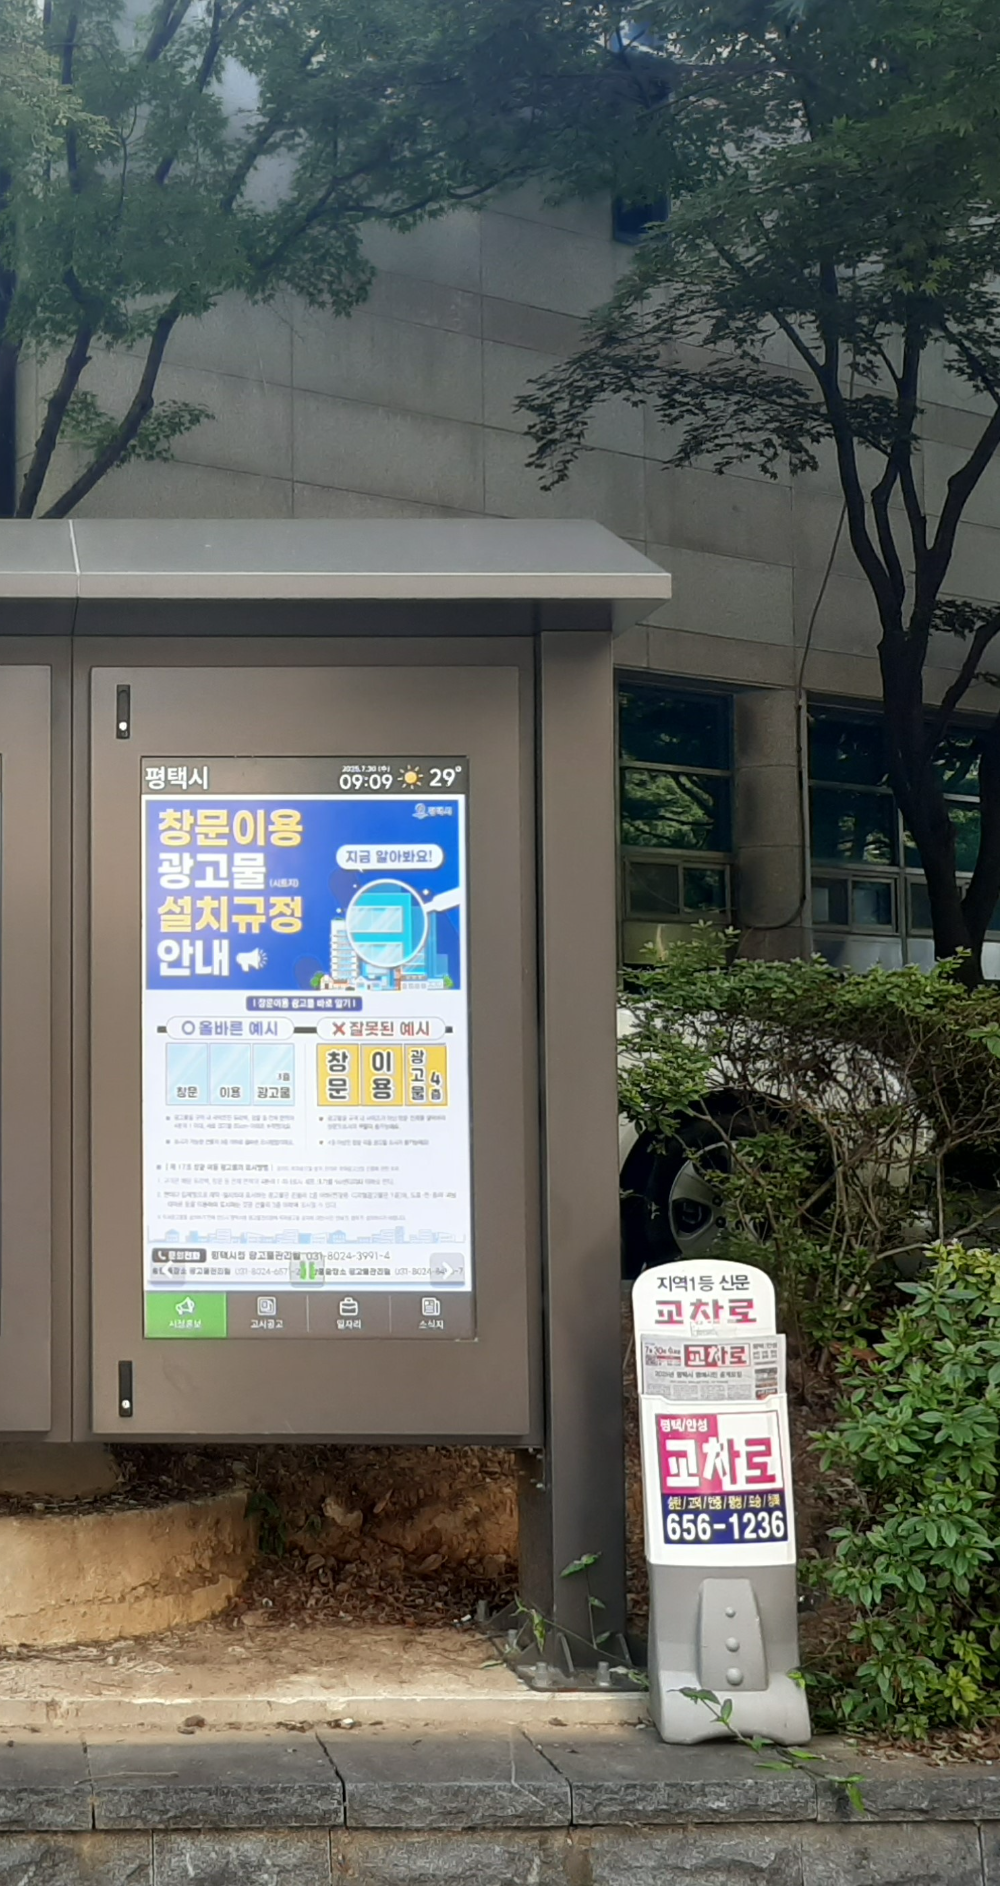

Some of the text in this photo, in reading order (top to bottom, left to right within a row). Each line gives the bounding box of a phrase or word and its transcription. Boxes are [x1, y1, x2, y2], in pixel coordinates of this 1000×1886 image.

[342, 765, 391, 773] 2025.7.30 (수)
[145, 766, 209, 790] 평택시
[339, 774, 393, 790] 09:09
[158, 808, 303, 847] 창문이용
[346, 849, 433, 863] 지금 알아봐요!
[158, 852, 299, 890] 광고물 (시트지)
[158, 896, 303, 934] 설치규정
[157, 939, 230, 976] 안내
[258, 998, 351, 1009] 창문이용 광고물 바로 알기
[199, 1020, 278, 1036] 올바른 예시
[350, 1020, 430, 1037] 잘못된 예시
[328, 1051, 348, 1100] 창문
[371, 1051, 392, 1100] 이용
[411, 1049, 425, 1101] 광고물
[177, 1086, 198, 1098] 창문
[219, 1086, 241, 1098] 이용
[257, 1086, 291, 1099] 광고물
[168, 1251, 200, 1260] 문의전화
[212, 1250, 245, 1260] 평택시청
[249, 1250, 300, 1260] 광고물관리팀
[657, 1274, 750, 1292] 지역1등 신문
[654, 1298, 757, 1325] 교차로
[169, 1319, 202, 1329] 시정홍보
[250, 1319, 283, 1329] 고시공고
[336, 1319, 361, 1329] 일자리
[418, 1319, 444, 1329] 소식지
[687, 1345, 747, 1366] 교차로
[660, 1418, 707, 1432] 평택/안성
[665, 1437, 776, 1487] 교차로
[667, 1511, 785, 1541] 656-1236
